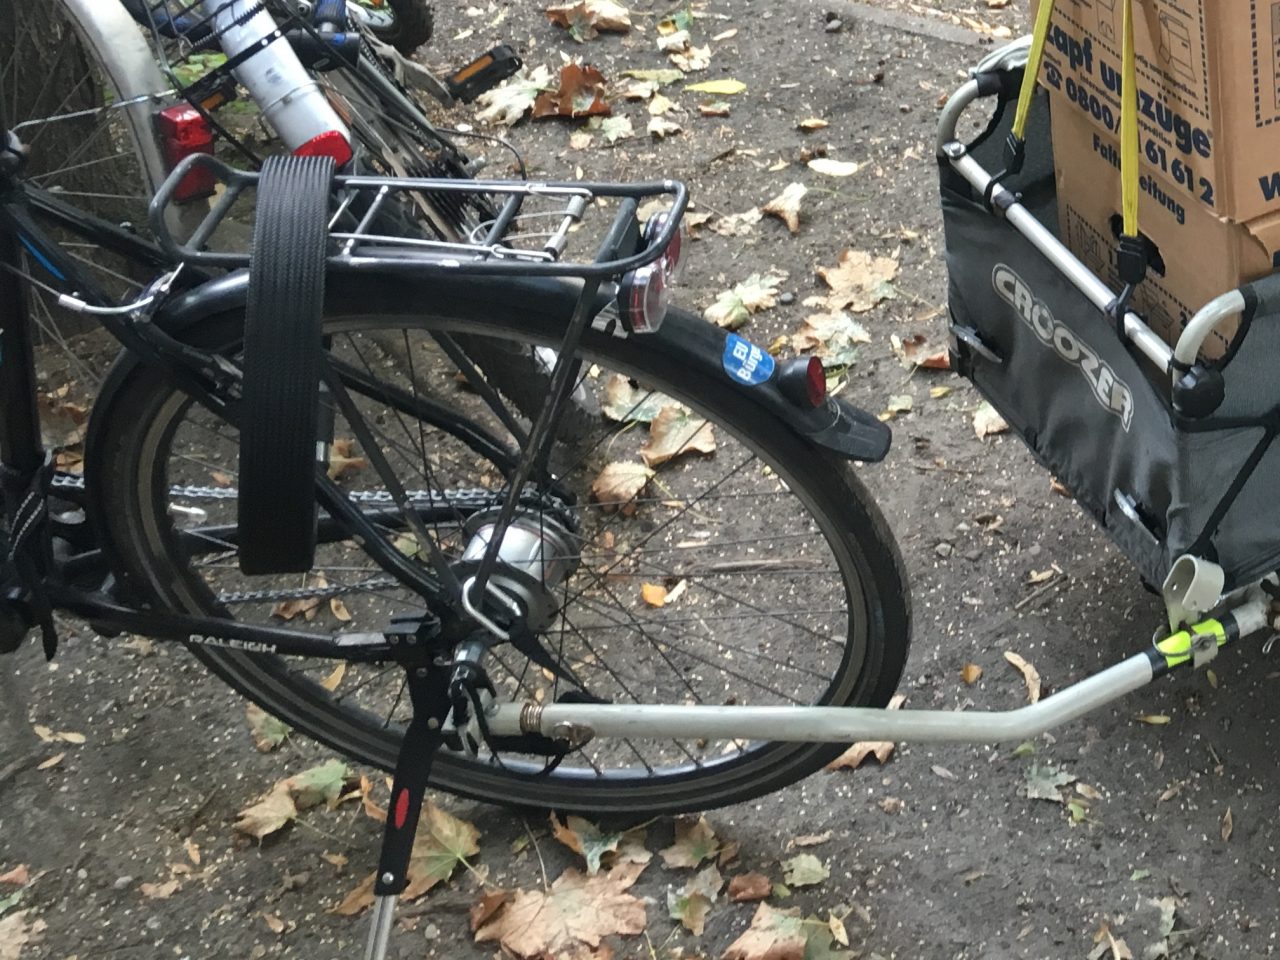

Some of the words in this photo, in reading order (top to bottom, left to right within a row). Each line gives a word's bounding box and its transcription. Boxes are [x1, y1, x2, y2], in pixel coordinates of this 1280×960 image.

[1145, 138, 1168, 173] 61
[1171, 157, 1194, 192] 61
[1199, 177, 1215, 208] 2
[994, 270, 1133, 426] CROOZER
[189, 634, 277, 654] RALEIGH
